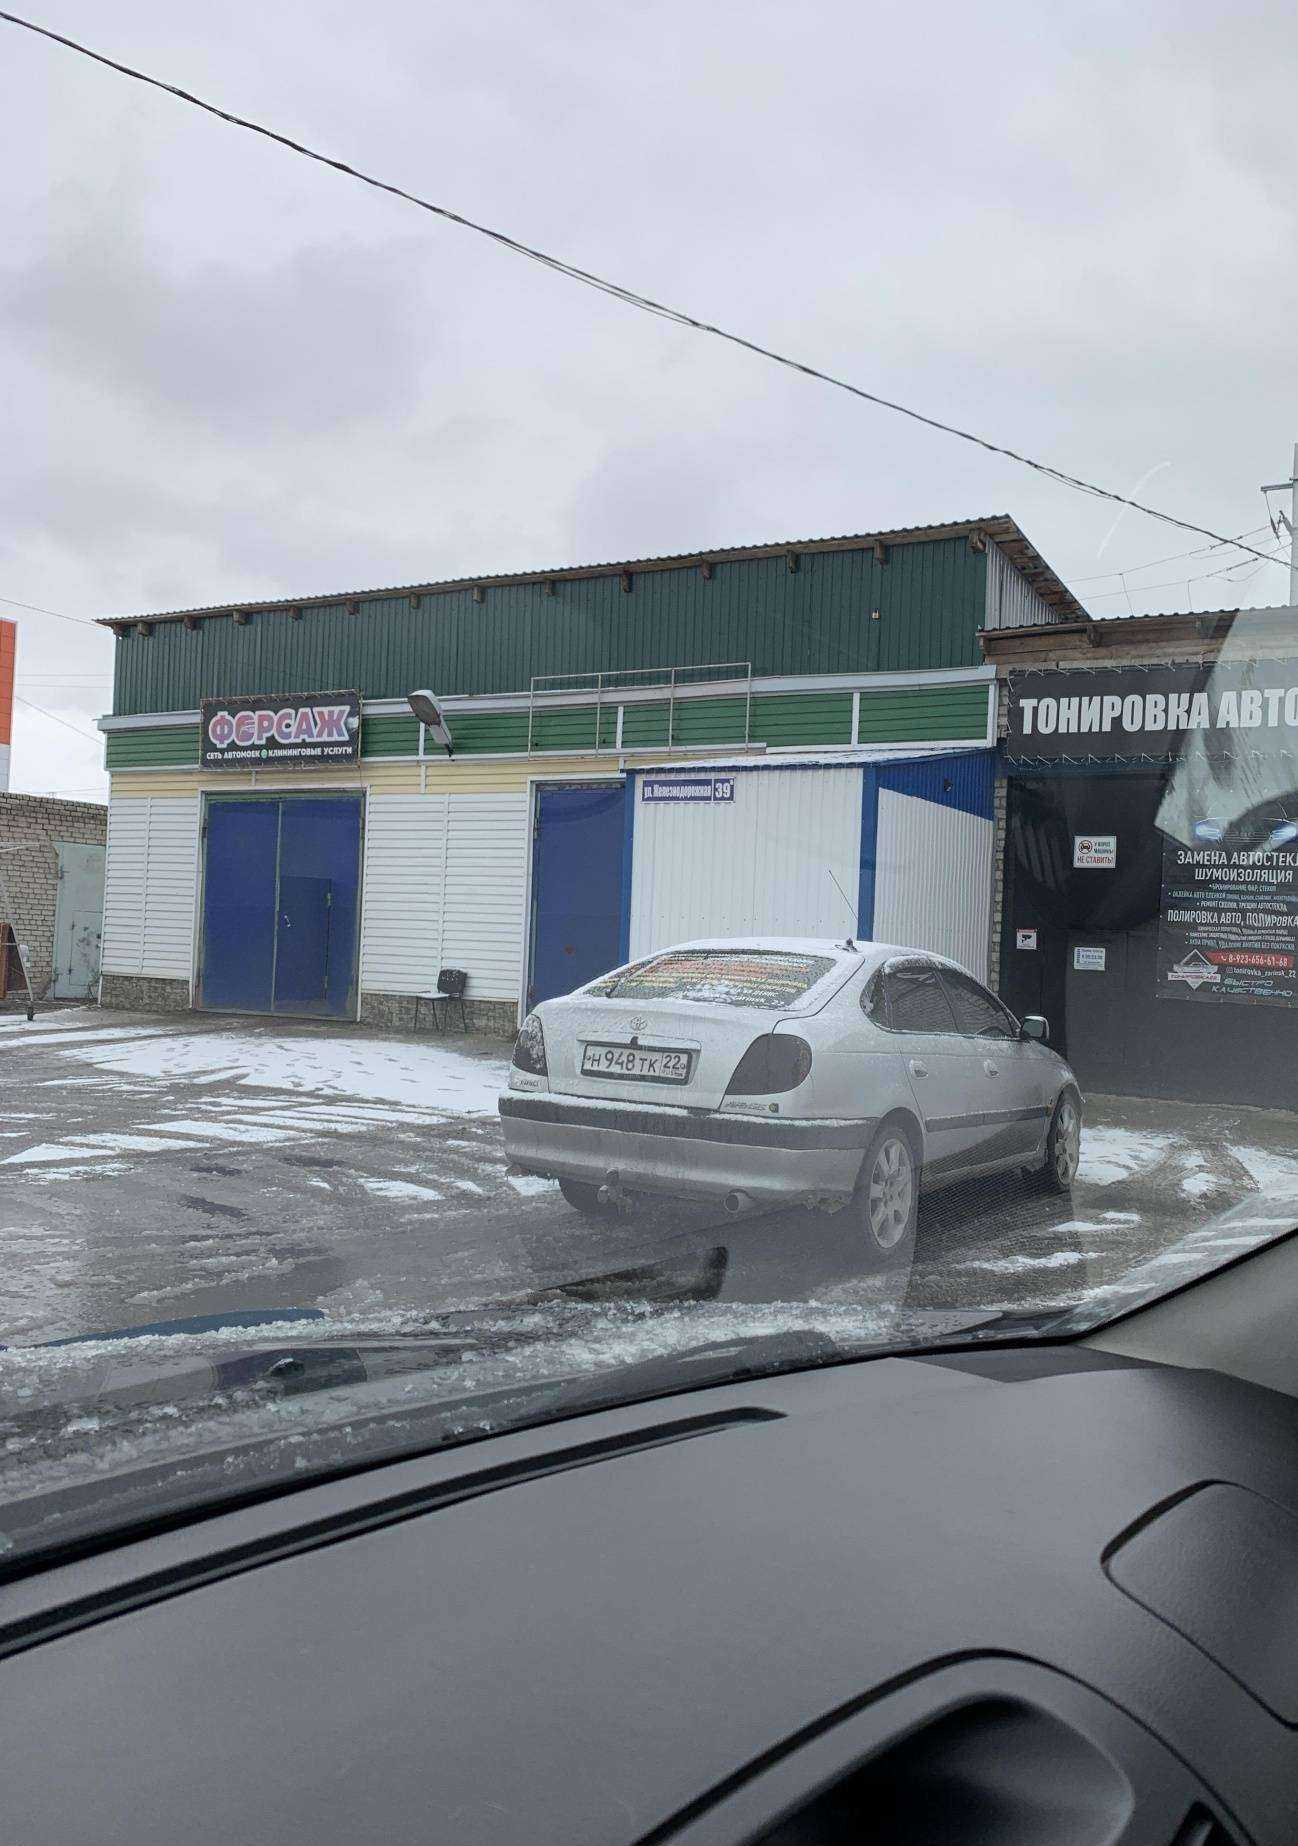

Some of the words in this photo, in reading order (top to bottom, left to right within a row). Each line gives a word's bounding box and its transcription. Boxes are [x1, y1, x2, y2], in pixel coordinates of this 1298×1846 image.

[1020, 692, 1210, 735] ТОНИРОВКА
[206, 751, 222, 760] СЕТЬ
[223, 750, 260, 760] АВТОМОЕК
[268, 747, 322, 758] КЛИНИНГОВЫЕ
[324, 746, 352, 756] УСЛУГИ
[1177, 851, 1227, 865] ЗАМЕНА
[1195, 868, 1293, 884] ШУМОИЗОЛЯЦИЯ
[1168, 909, 1218, 924] ПОЛИРОВКА
[1220, 912, 1244, 926] АВТО,
